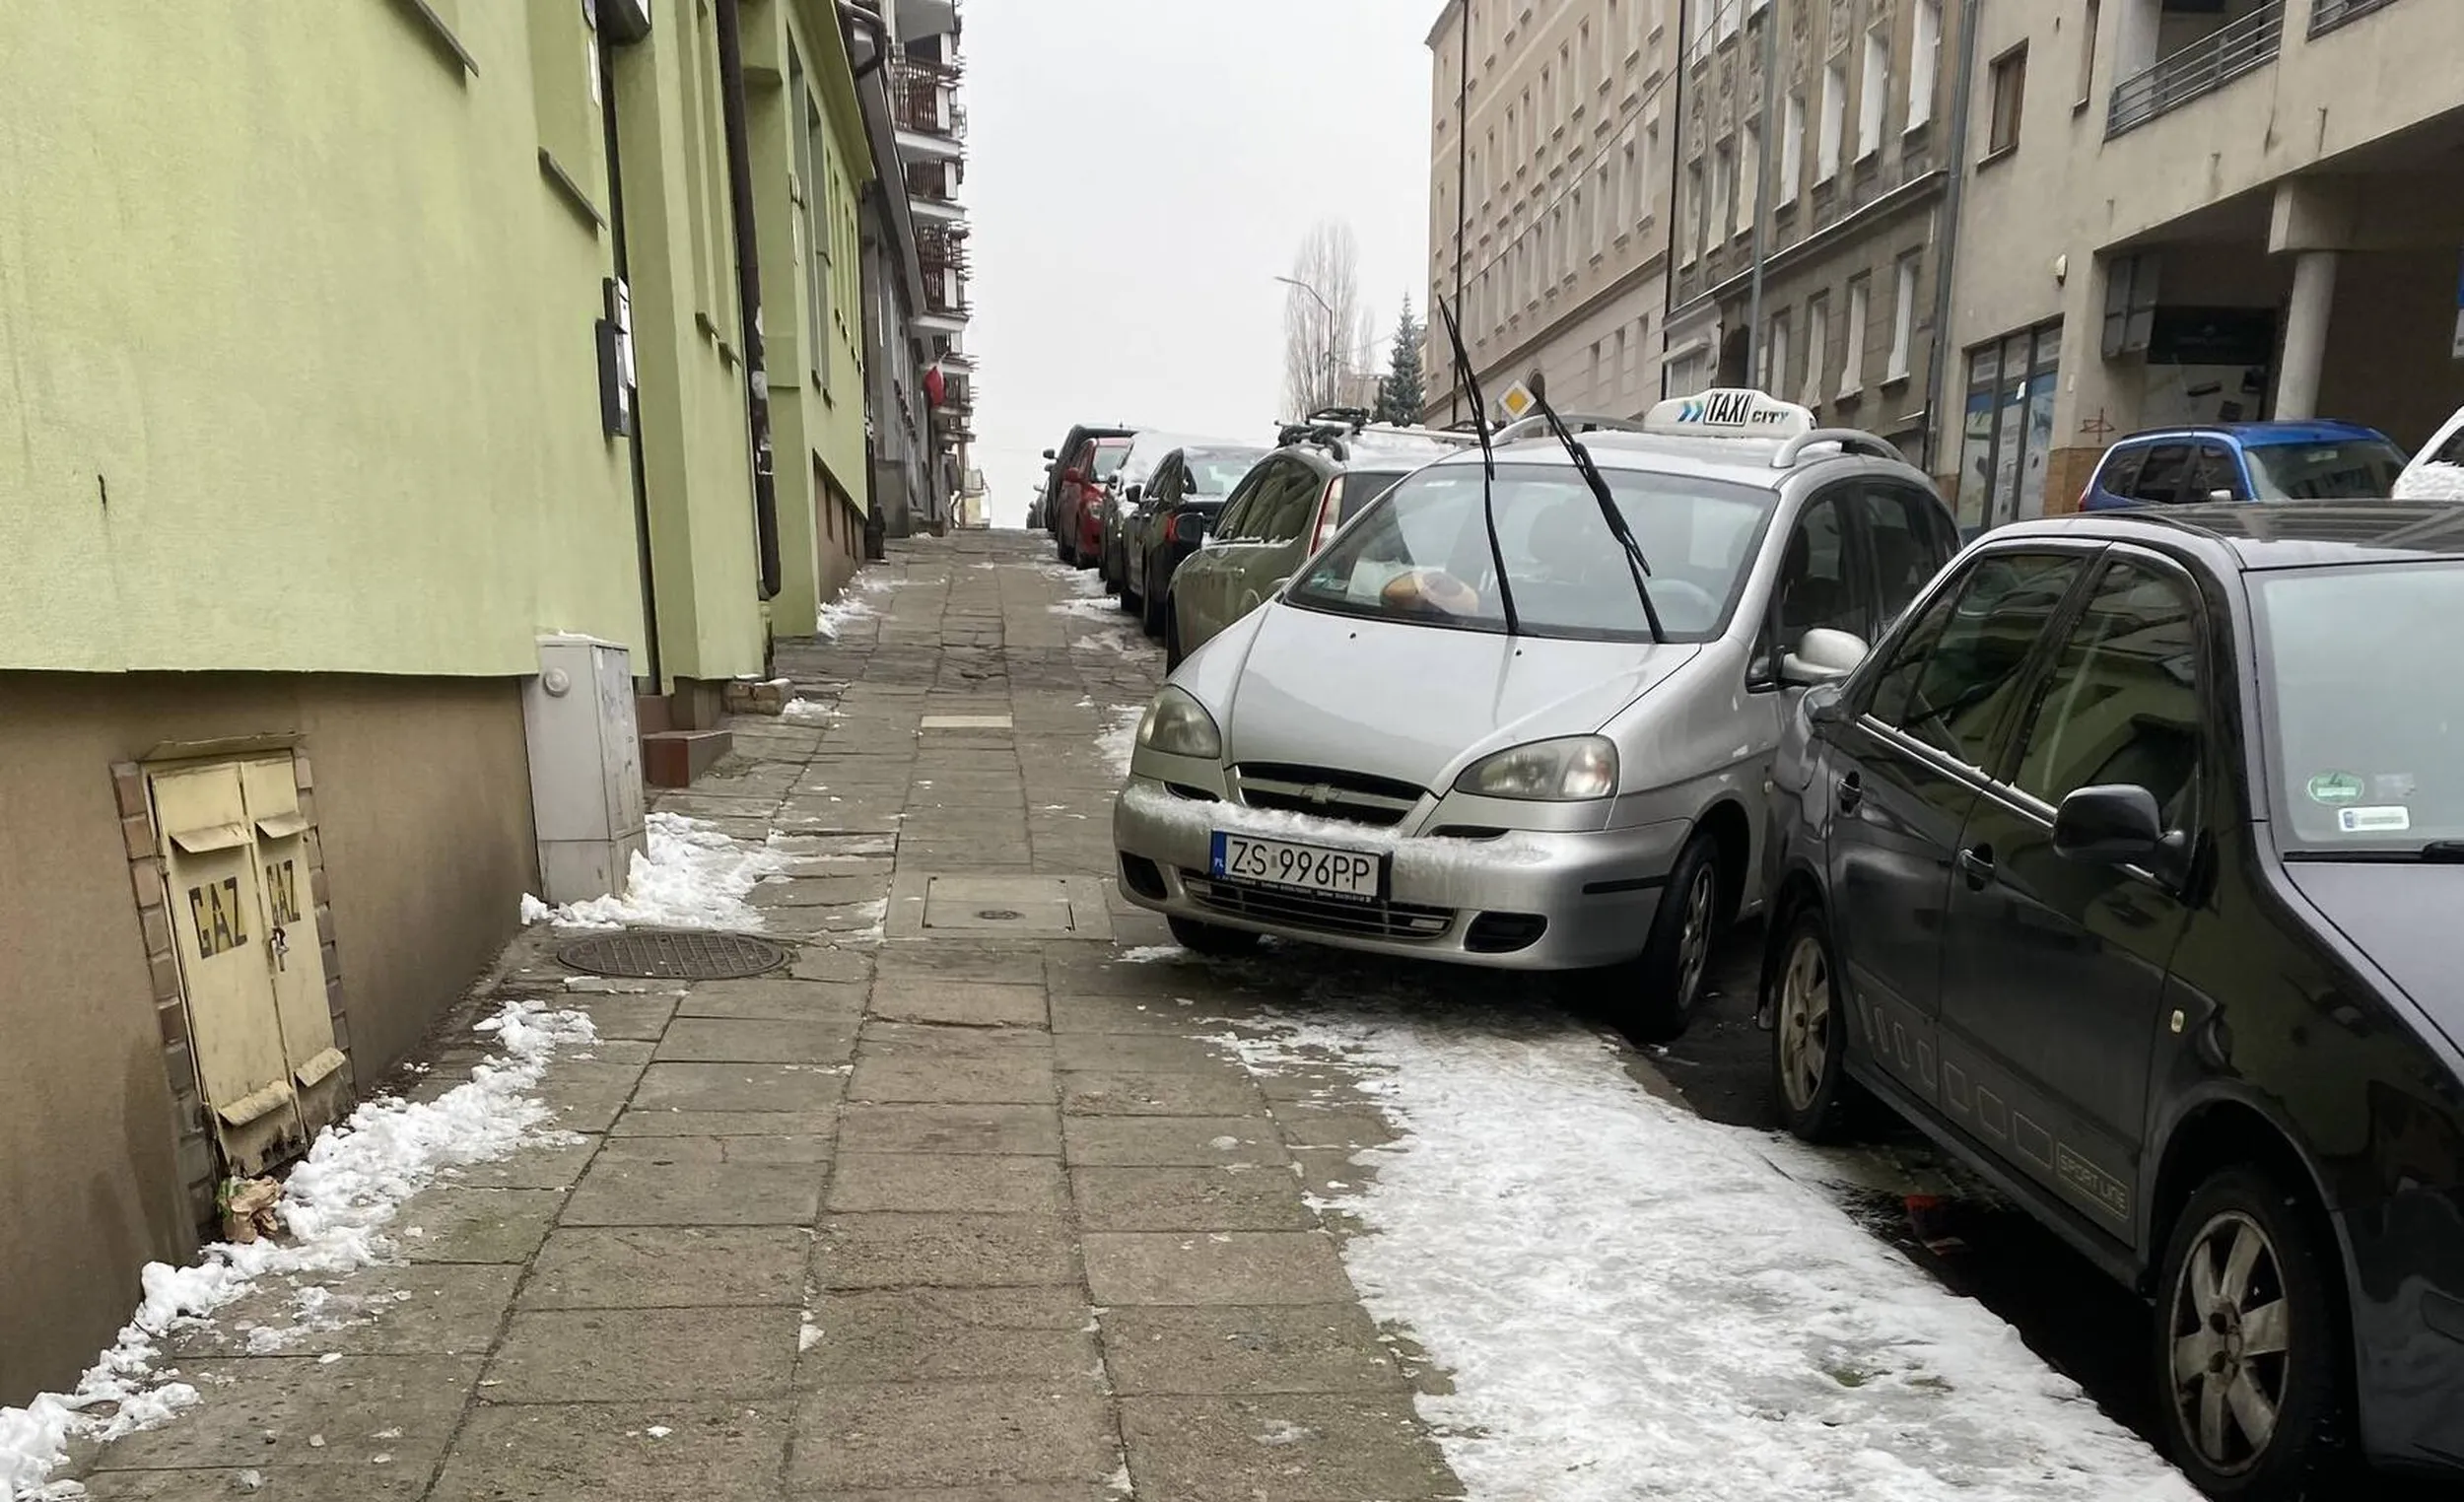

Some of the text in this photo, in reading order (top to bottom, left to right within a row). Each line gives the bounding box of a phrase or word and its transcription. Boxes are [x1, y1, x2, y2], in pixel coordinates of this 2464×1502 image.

[1708, 393, 1789, 424] TAXI CITY
[265, 859, 301, 928] GAZ
[1232, 840, 1371, 890] ZS 996PP
[188, 876, 247, 960] GAZ
